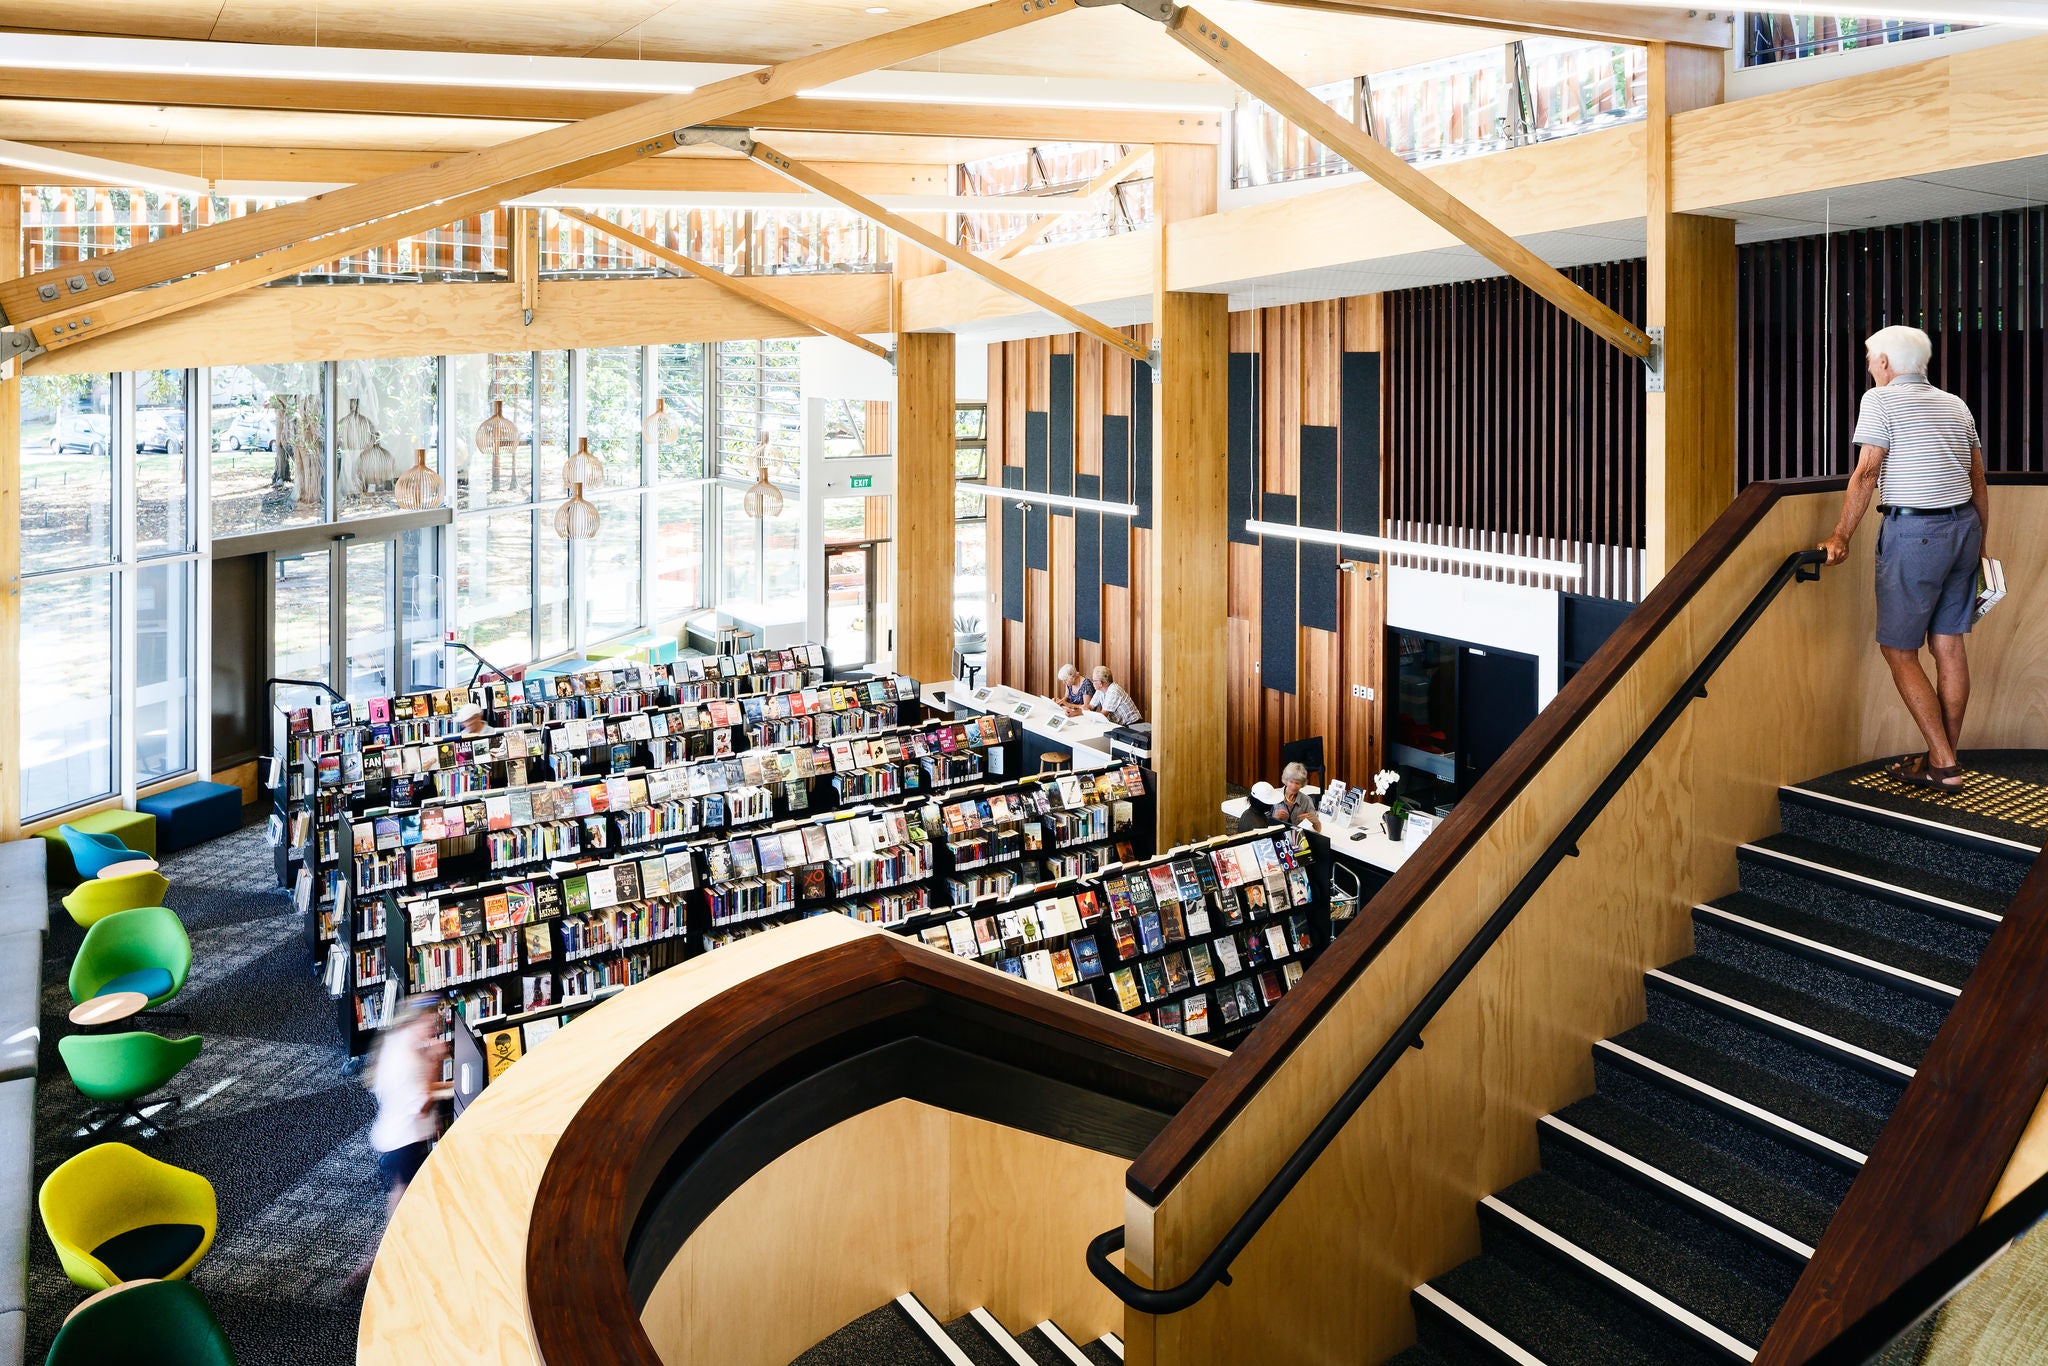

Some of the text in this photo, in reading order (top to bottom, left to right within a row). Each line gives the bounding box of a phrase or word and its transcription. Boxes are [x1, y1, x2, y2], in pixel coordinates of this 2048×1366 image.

[854, 479, 869, 487] EXIT
[364, 757, 381, 768] FAN
[803, 869, 825, 886] XO
[1108, 880, 1127, 889] STUART
[1131, 882, 1149, 892] COOK
[1188, 1003, 1206, 1013] WHITE
